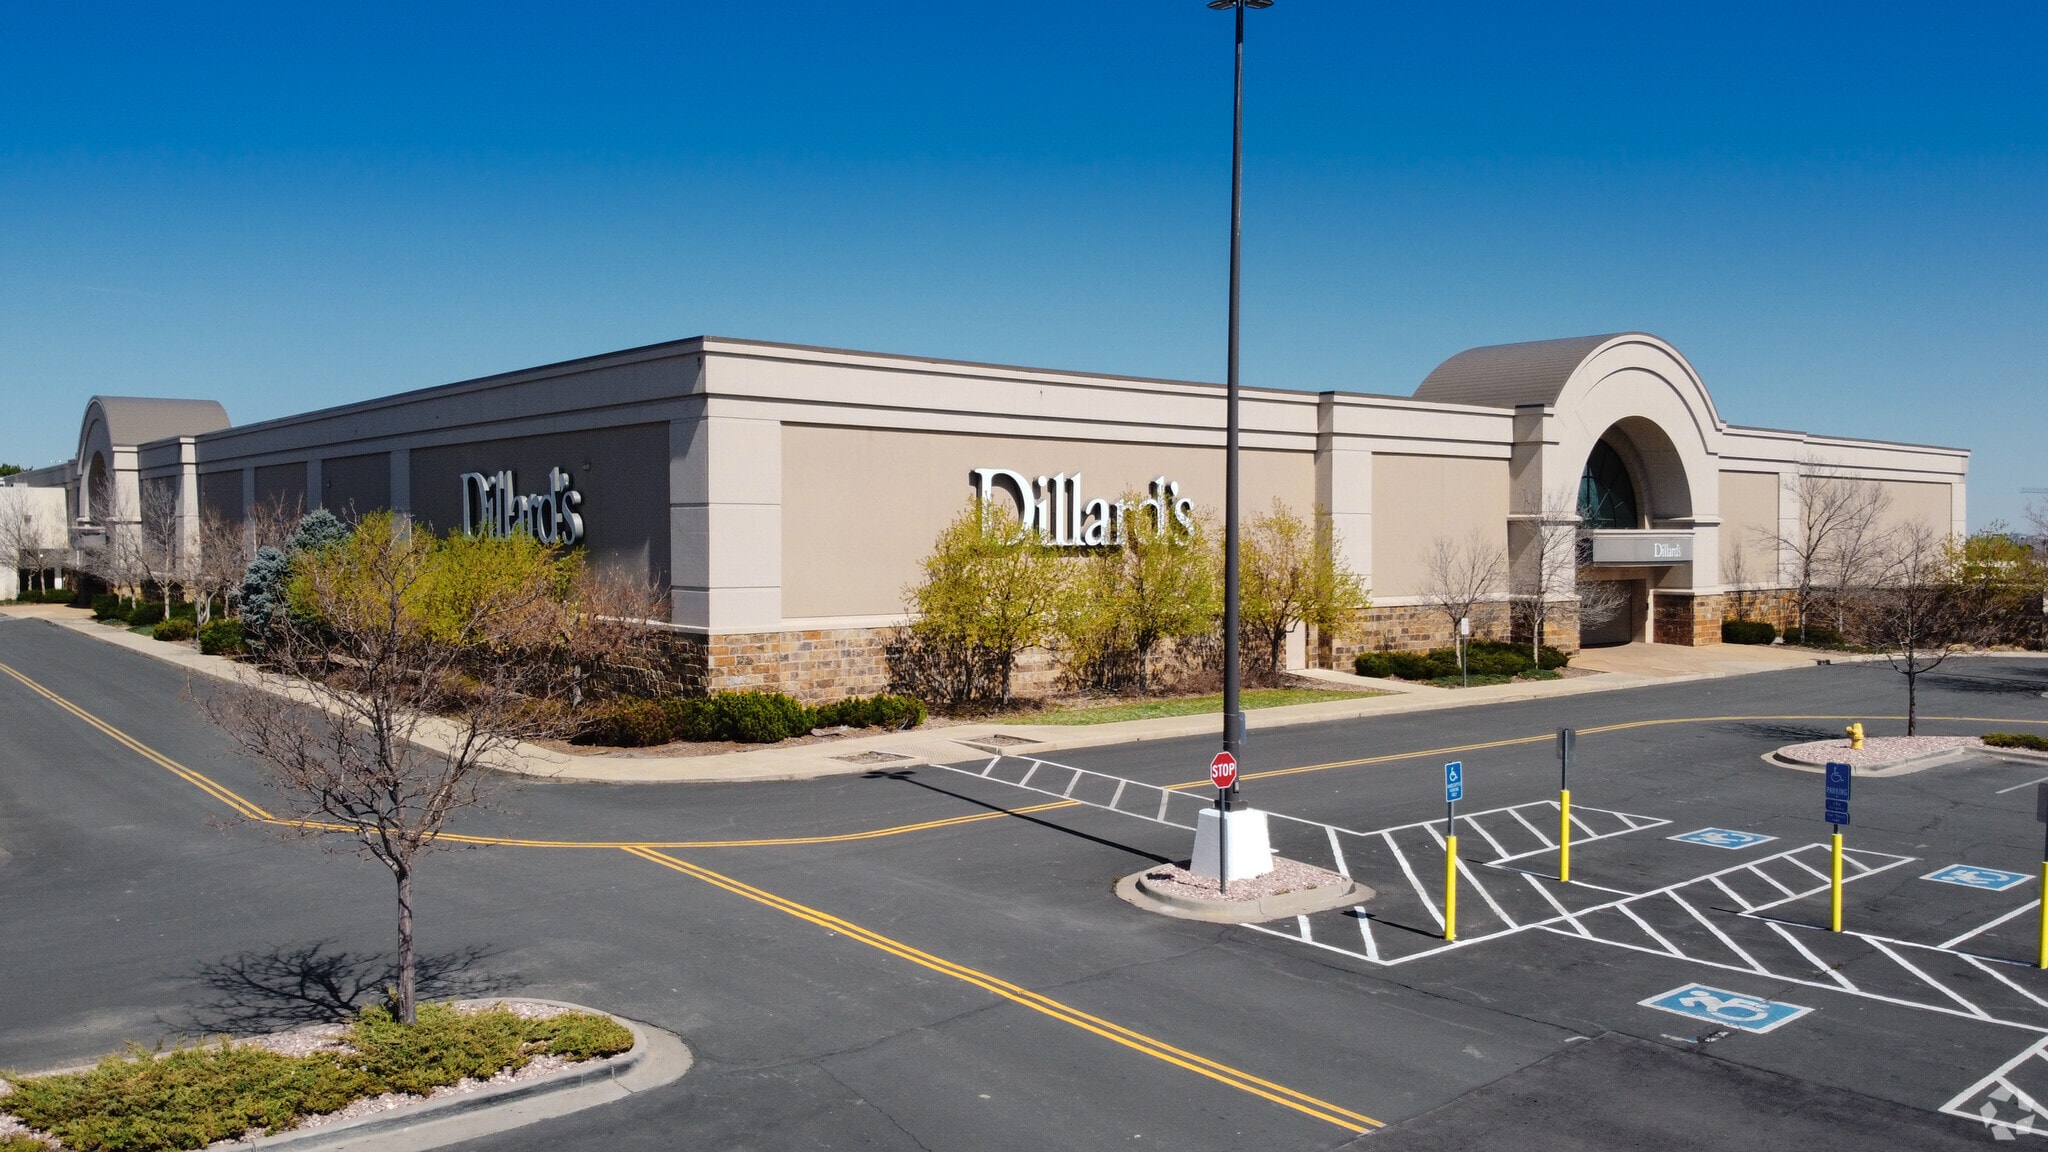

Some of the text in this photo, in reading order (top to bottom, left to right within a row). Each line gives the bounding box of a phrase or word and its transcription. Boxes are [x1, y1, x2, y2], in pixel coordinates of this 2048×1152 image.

[460, 466, 584, 545] Dillard's
[973, 468, 1194, 547] Dillard's
[1212, 762, 1235, 778] STOP
[1826, 787, 1847, 796] PARKING
